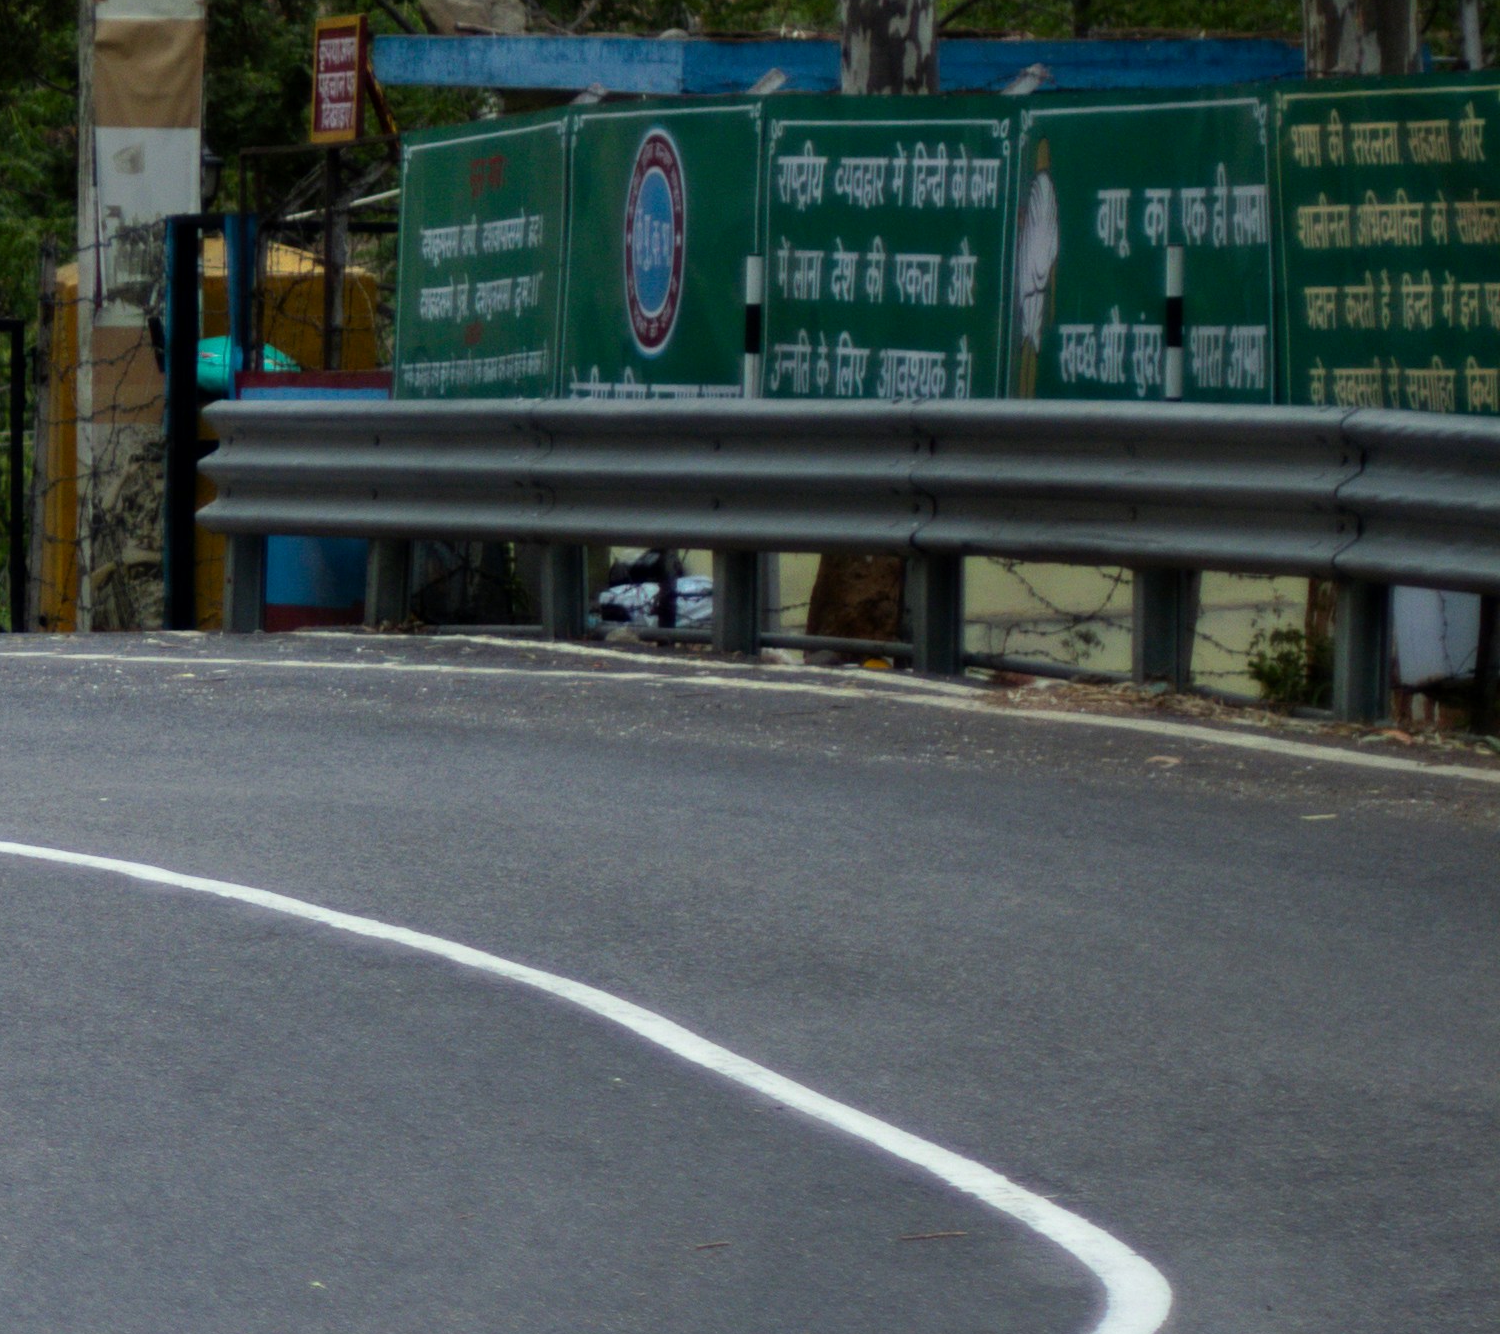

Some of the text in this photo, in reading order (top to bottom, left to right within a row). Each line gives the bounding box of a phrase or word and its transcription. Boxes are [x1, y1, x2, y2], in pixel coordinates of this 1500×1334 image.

[1327, 108, 1344, 166] की
[1458, 100, 1486, 163] और
[777, 139, 1001, 211] राष्ट्रीय व्यवहार में हिन्दी को काम
[1097, 161, 1269, 259] बापू का एक ही सपना
[1431, 189, 1449, 245] को
[777, 235, 978, 306] में लाना देश की एकता और
[1344, 269, 1376, 329] करती
[1401, 268, 1434, 330] हिन्दी
[771, 328, 812, 394] उन्नति
[816, 330, 830, 395] के
[836, 331, 870, 396] लिए
[877, 348, 947, 398] आवश्यक
[1058, 304, 1267, 398] स्वच्छ और सुंदर भारत अपना
[1310, 355, 1327, 406] को
[1388, 355, 1400, 408] से
